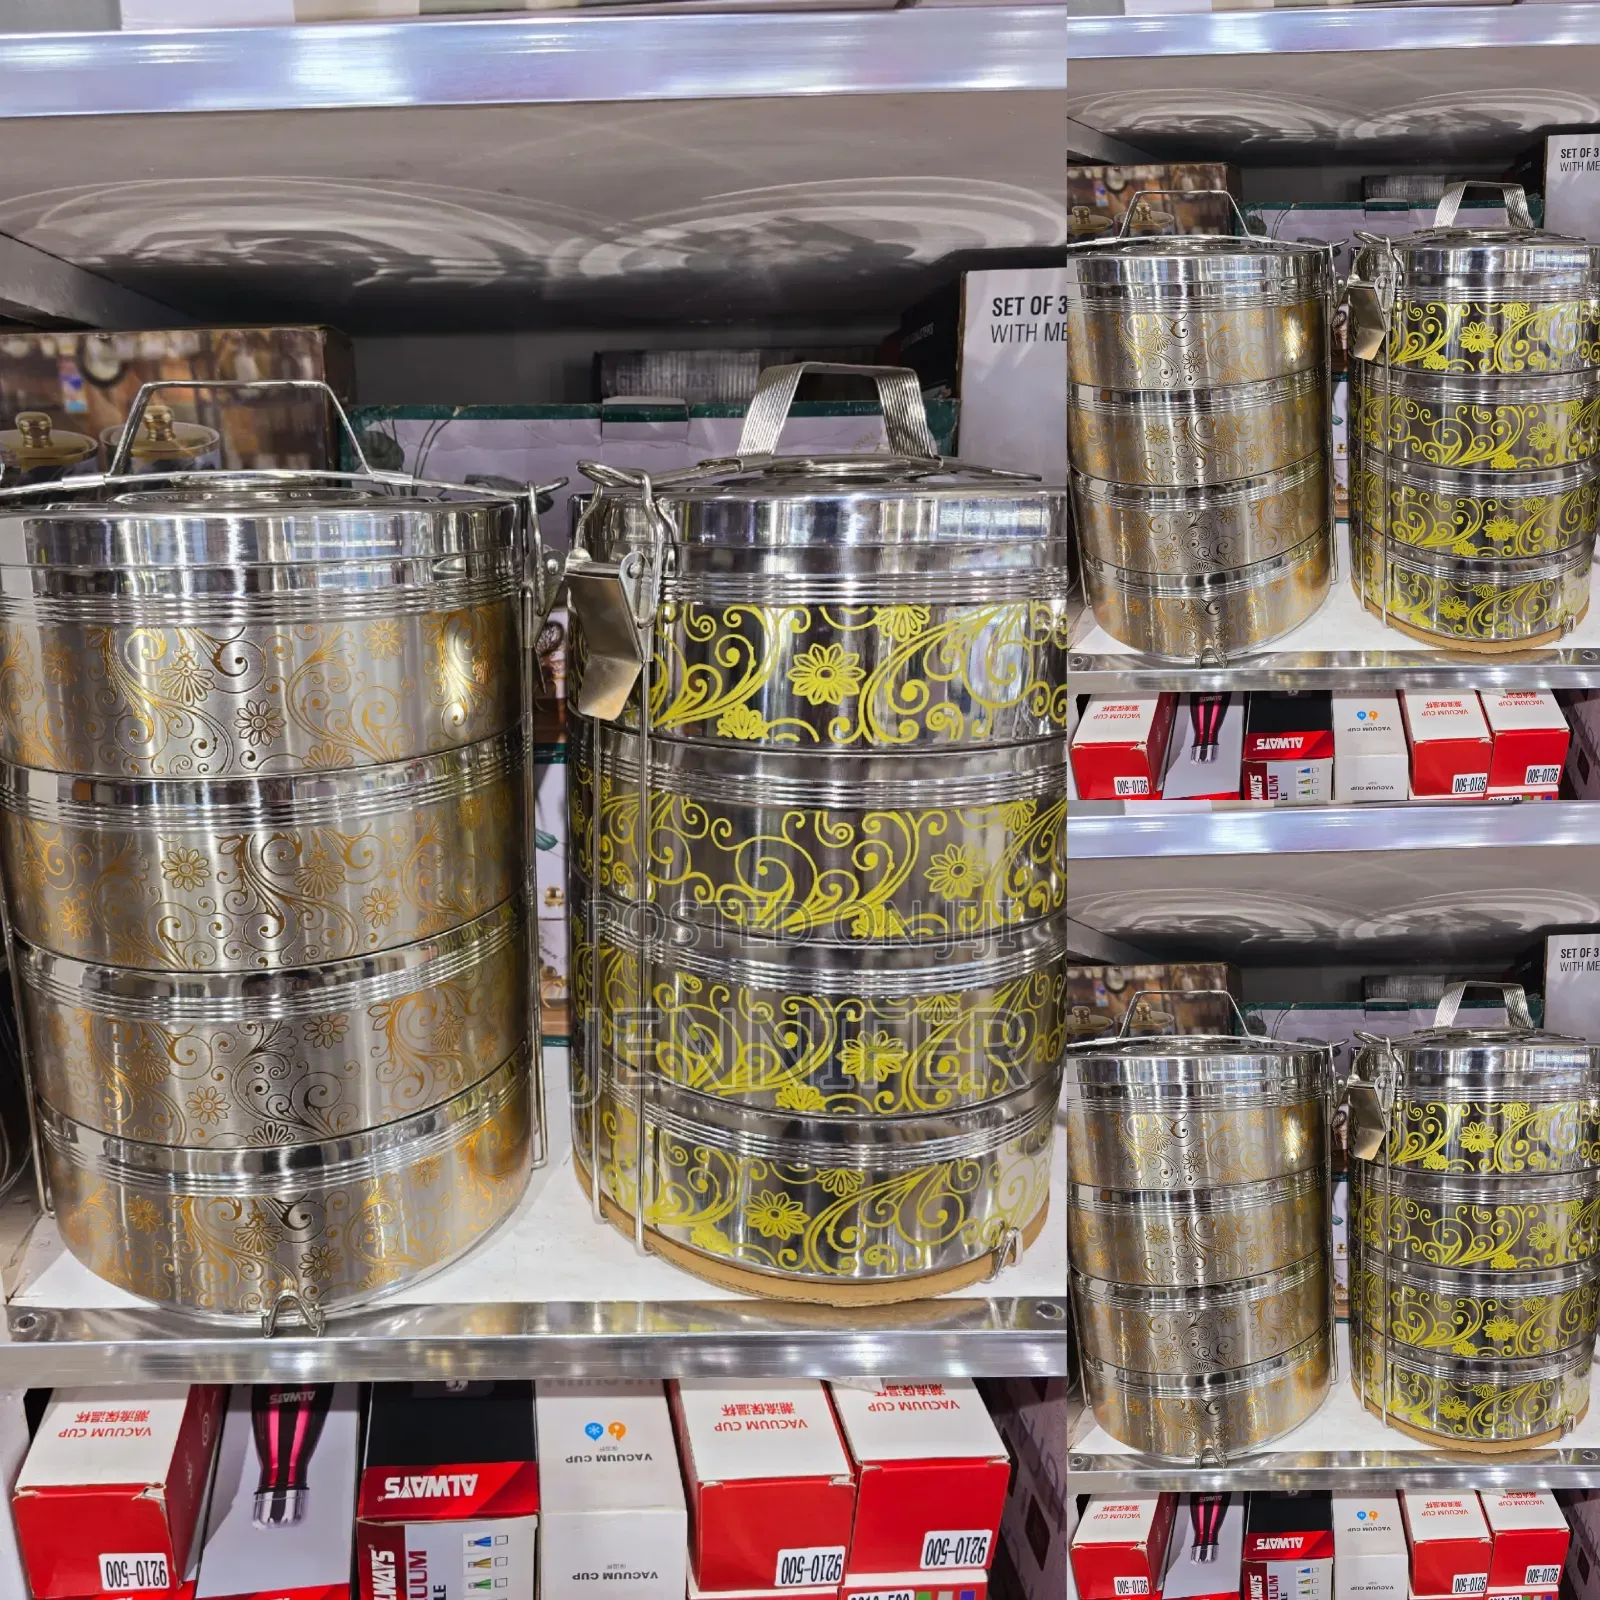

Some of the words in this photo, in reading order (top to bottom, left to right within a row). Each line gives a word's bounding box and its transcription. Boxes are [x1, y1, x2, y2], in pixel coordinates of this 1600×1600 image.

[1560, 148, 1577, 158] SET
[1580, 147, 1592, 158] OF
[1594, 147, 1599, 158] 3
[1560, 161, 1583, 171] WITH
[992, 297, 1025, 317] SET
[1030, 296, 1054, 316] OF
[1058, 295, 1067, 315] 3
[991, 323, 1038, 344] WITH
[1256, 736, 1304, 750] ALWAYS
[1526, 768, 1559, 784] 9210-500
[1116, 780, 1149, 794] 9210-500
[1454, 777, 1486, 793] 9210-500
[1560, 948, 1577, 958] SET
[1580, 947, 1592, 958] OF
[1594, 947, 1599, 958] 3
[1560, 961, 1583, 971] WITH
[268, 1390, 317, 1405] ALWAYS
[720, 1401, 795, 1417] 潮流保温杯
[867, 1401, 895, 1413] CUP
[898, 1399, 960, 1411] VACUUM
[74, 1410, 151, 1424] 潮流保温杯
[714, 1420, 742, 1432] CUP
[746, 1418, 809, 1431] VACUUM
[58, 1427, 88, 1439] CUP
[91, 1426, 153, 1439] VACUUM
[565, 1454, 591, 1464] CUP
[595, 1453, 653, 1463] VACUUM
[383, 1473, 479, 1499] ALWAYS
[1256, 1536, 1304, 1550] ALWAYS
[924, 1536, 988, 1566] 9210-500
[105, 1559, 168, 1588] 9210-500
[572, 1572, 599, 1581] CUP
[602, 1571, 659, 1580] VACUUM
[780, 1554, 843, 1585] 9210-500
[1526, 1568, 1559, 1584] 9210-500
[1116, 1580, 1149, 1594] 9210-500
[1454, 1577, 1486, 1593] 9210-500
